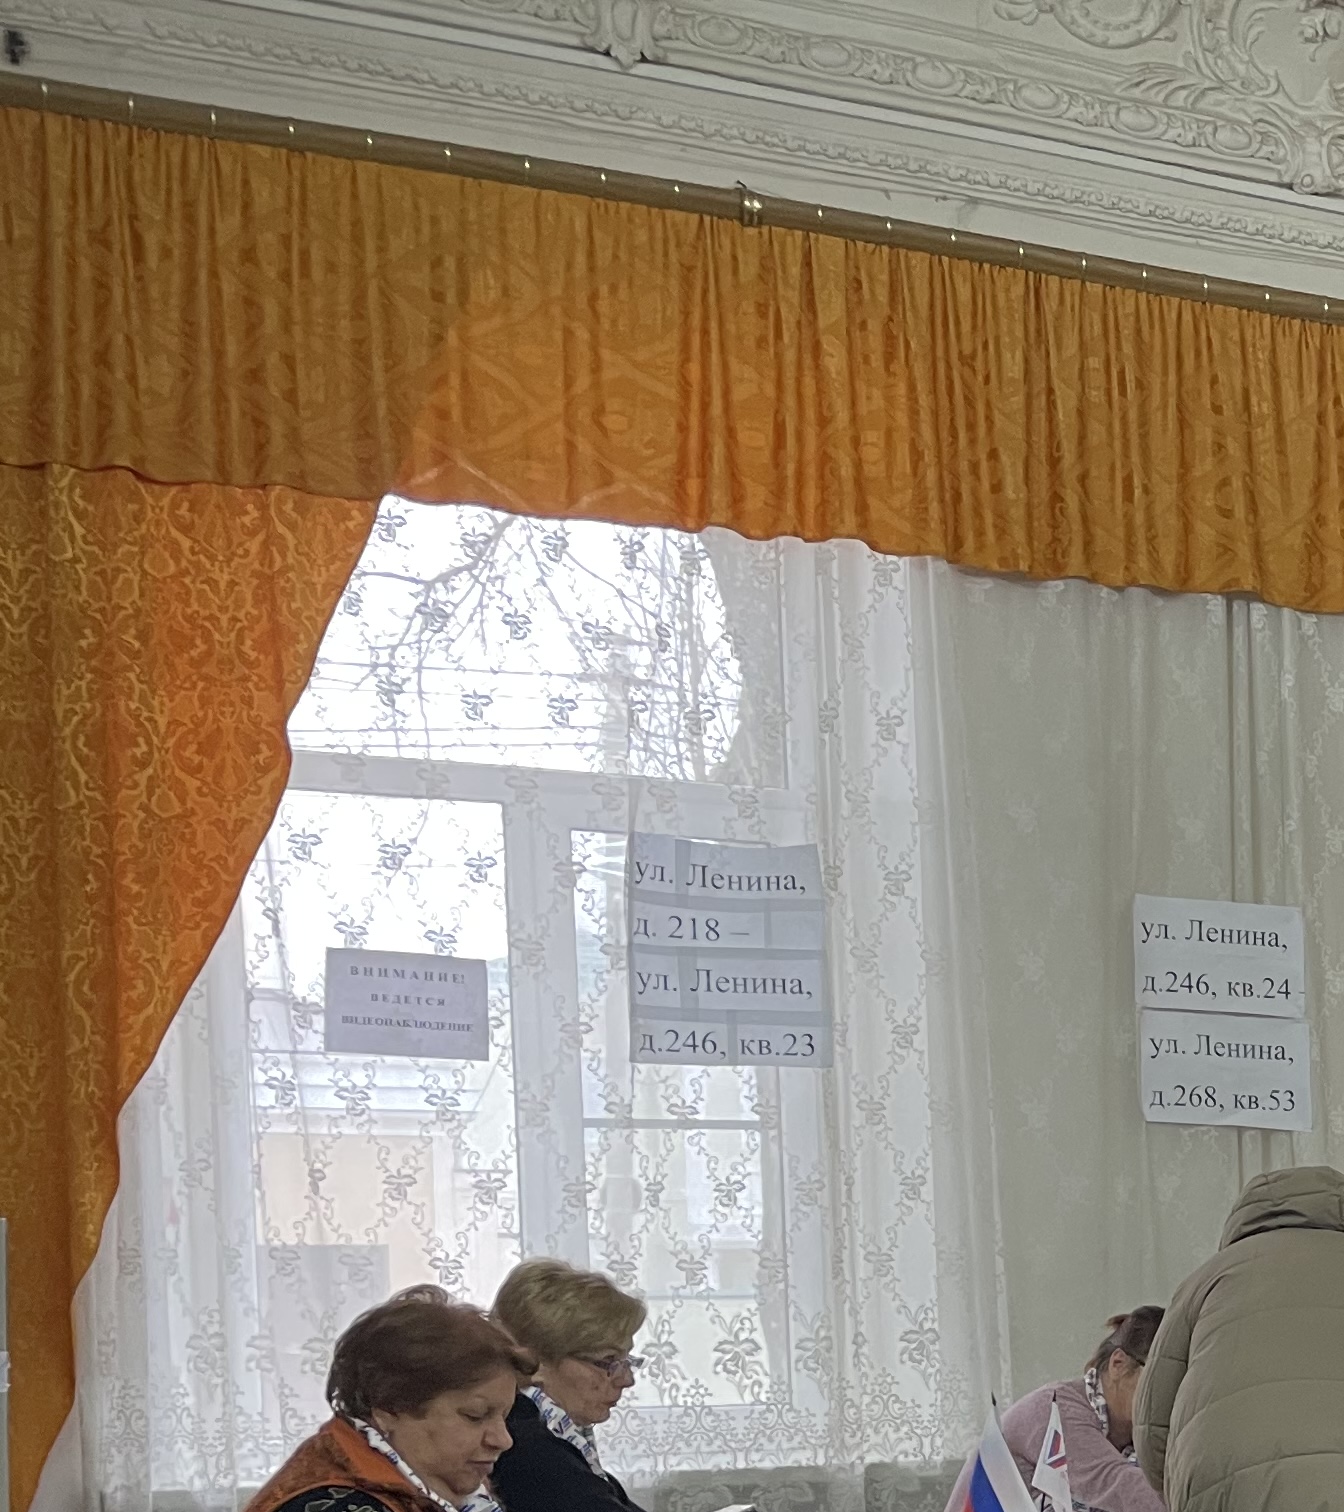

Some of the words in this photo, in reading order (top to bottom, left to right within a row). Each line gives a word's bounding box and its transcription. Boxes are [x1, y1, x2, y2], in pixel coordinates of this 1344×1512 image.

[635, 861, 673, 884] ул.
[686, 863, 806, 895] Ленина,
[633, 917, 657, 939] д.
[667, 915, 720, 942] 218
[1141, 921, 1176, 944] ул.
[1184, 919, 1288, 953] Ленина,
[636, 971, 677, 996] ул.
[690, 968, 813, 1000] Ленина,
[1142, 971, 1217, 1000] д.246,
[1227, 977, 1292, 1000] кв.24
[370, 993, 446, 1007] ВЕДЕТСЯ
[639, 1029, 726, 1060] д.246,
[739, 1033, 815, 1058] кв.23
[1149, 1037, 1186, 1059] ул.
[1193, 1034, 1294, 1066] Ленина,
[1149, 1084, 1225, 1112] д.268,
[1233, 1089, 1295, 1112] кв.53
